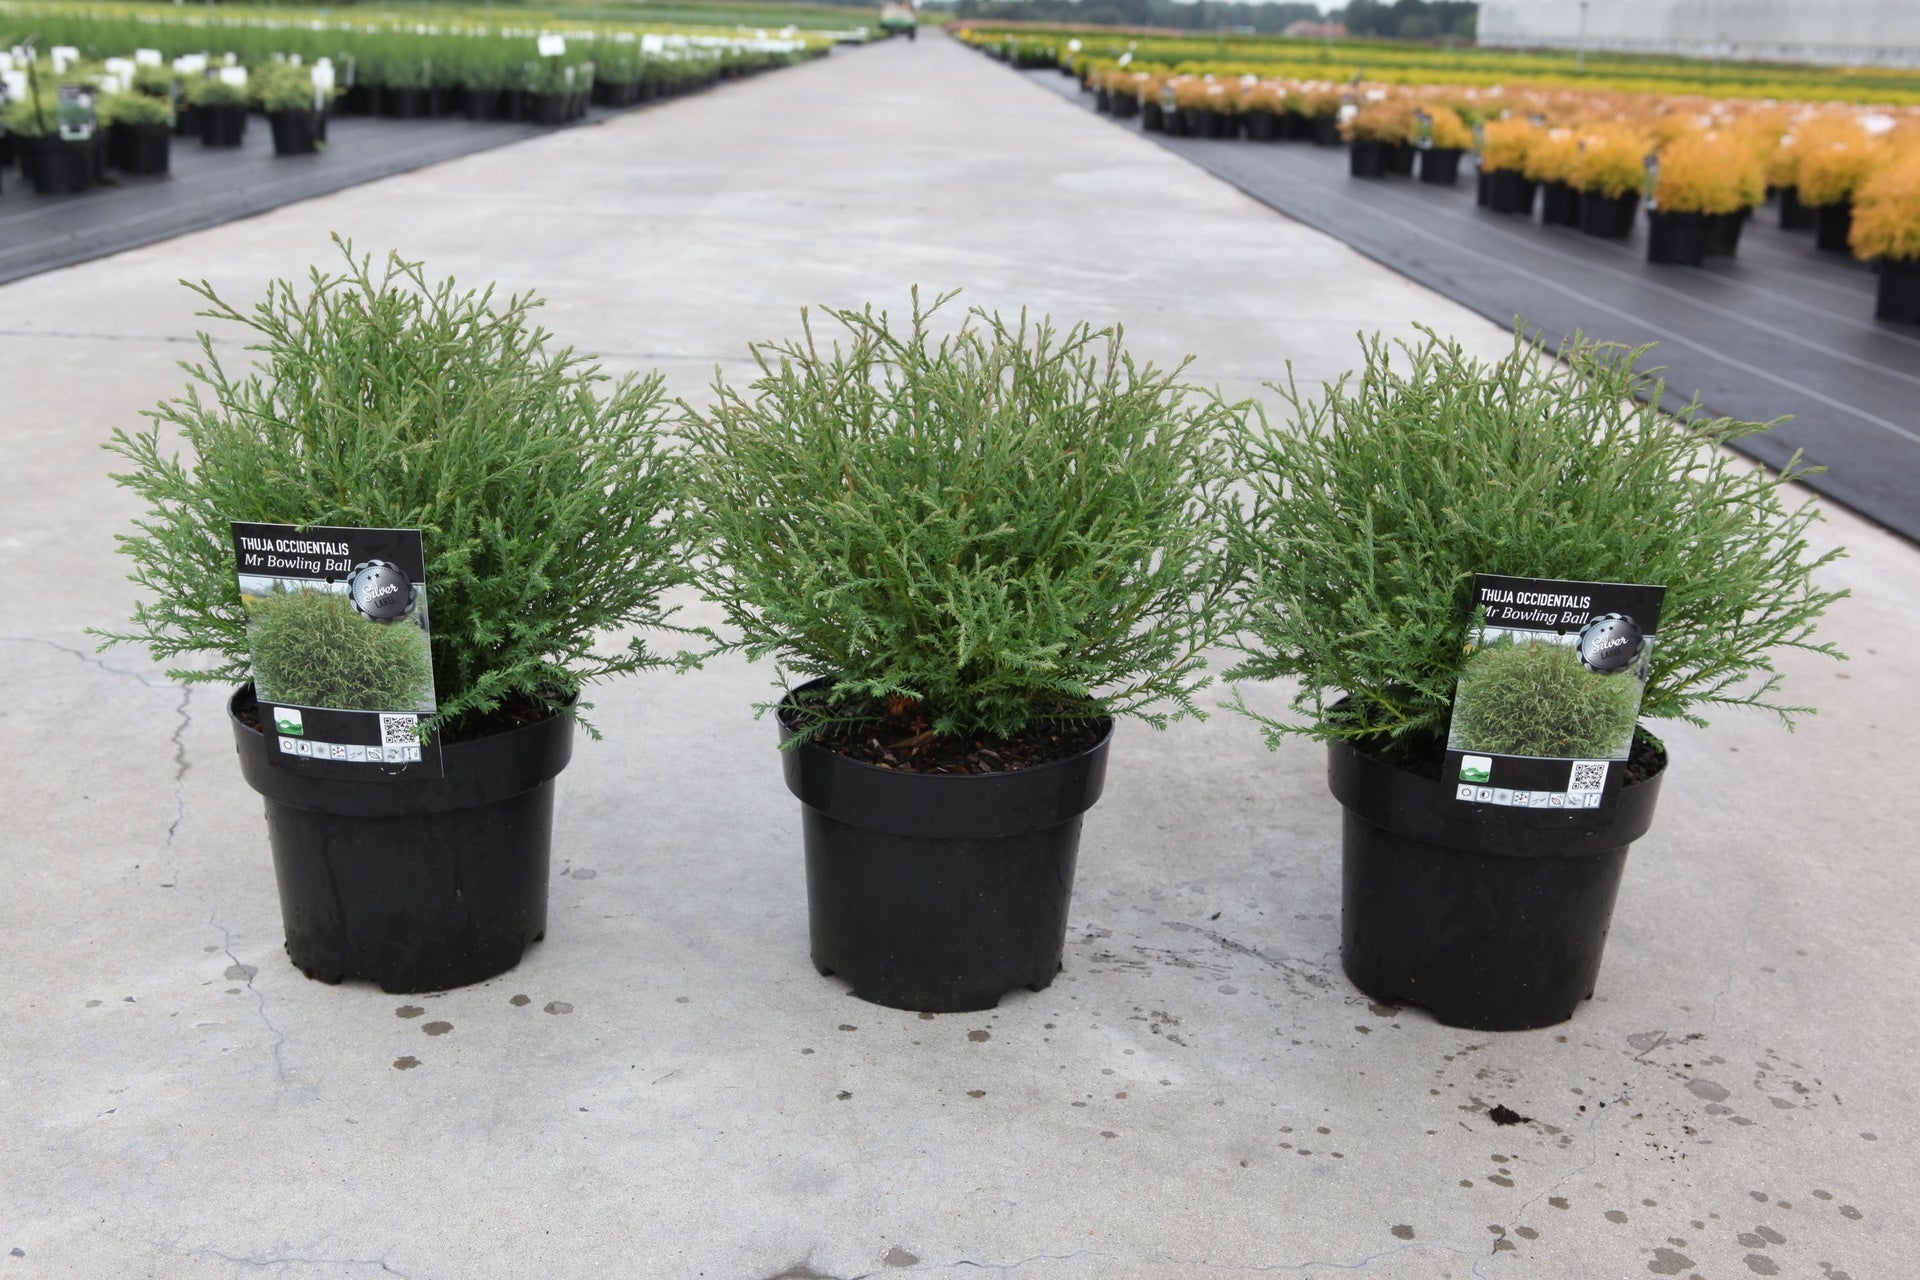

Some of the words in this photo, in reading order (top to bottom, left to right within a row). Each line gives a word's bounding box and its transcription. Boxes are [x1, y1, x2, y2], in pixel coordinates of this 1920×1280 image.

[241, 537, 275, 551] THUJA
[276, 539, 349, 556] OCCIDENTALIS
[244, 553, 264, 566] Mr
[267, 555, 321, 573] Bowling
[325, 558, 351, 572] Ball
[362, 582, 399, 602] Silver
[1481, 588, 1514, 603] THUJA
[1516, 591, 1591, 609] OCCIDENTALIS
[1501, 606, 1557, 625] Bowling
[1560, 611, 1589, 624] Ball
[1592, 635, 1629, 654] Silver
